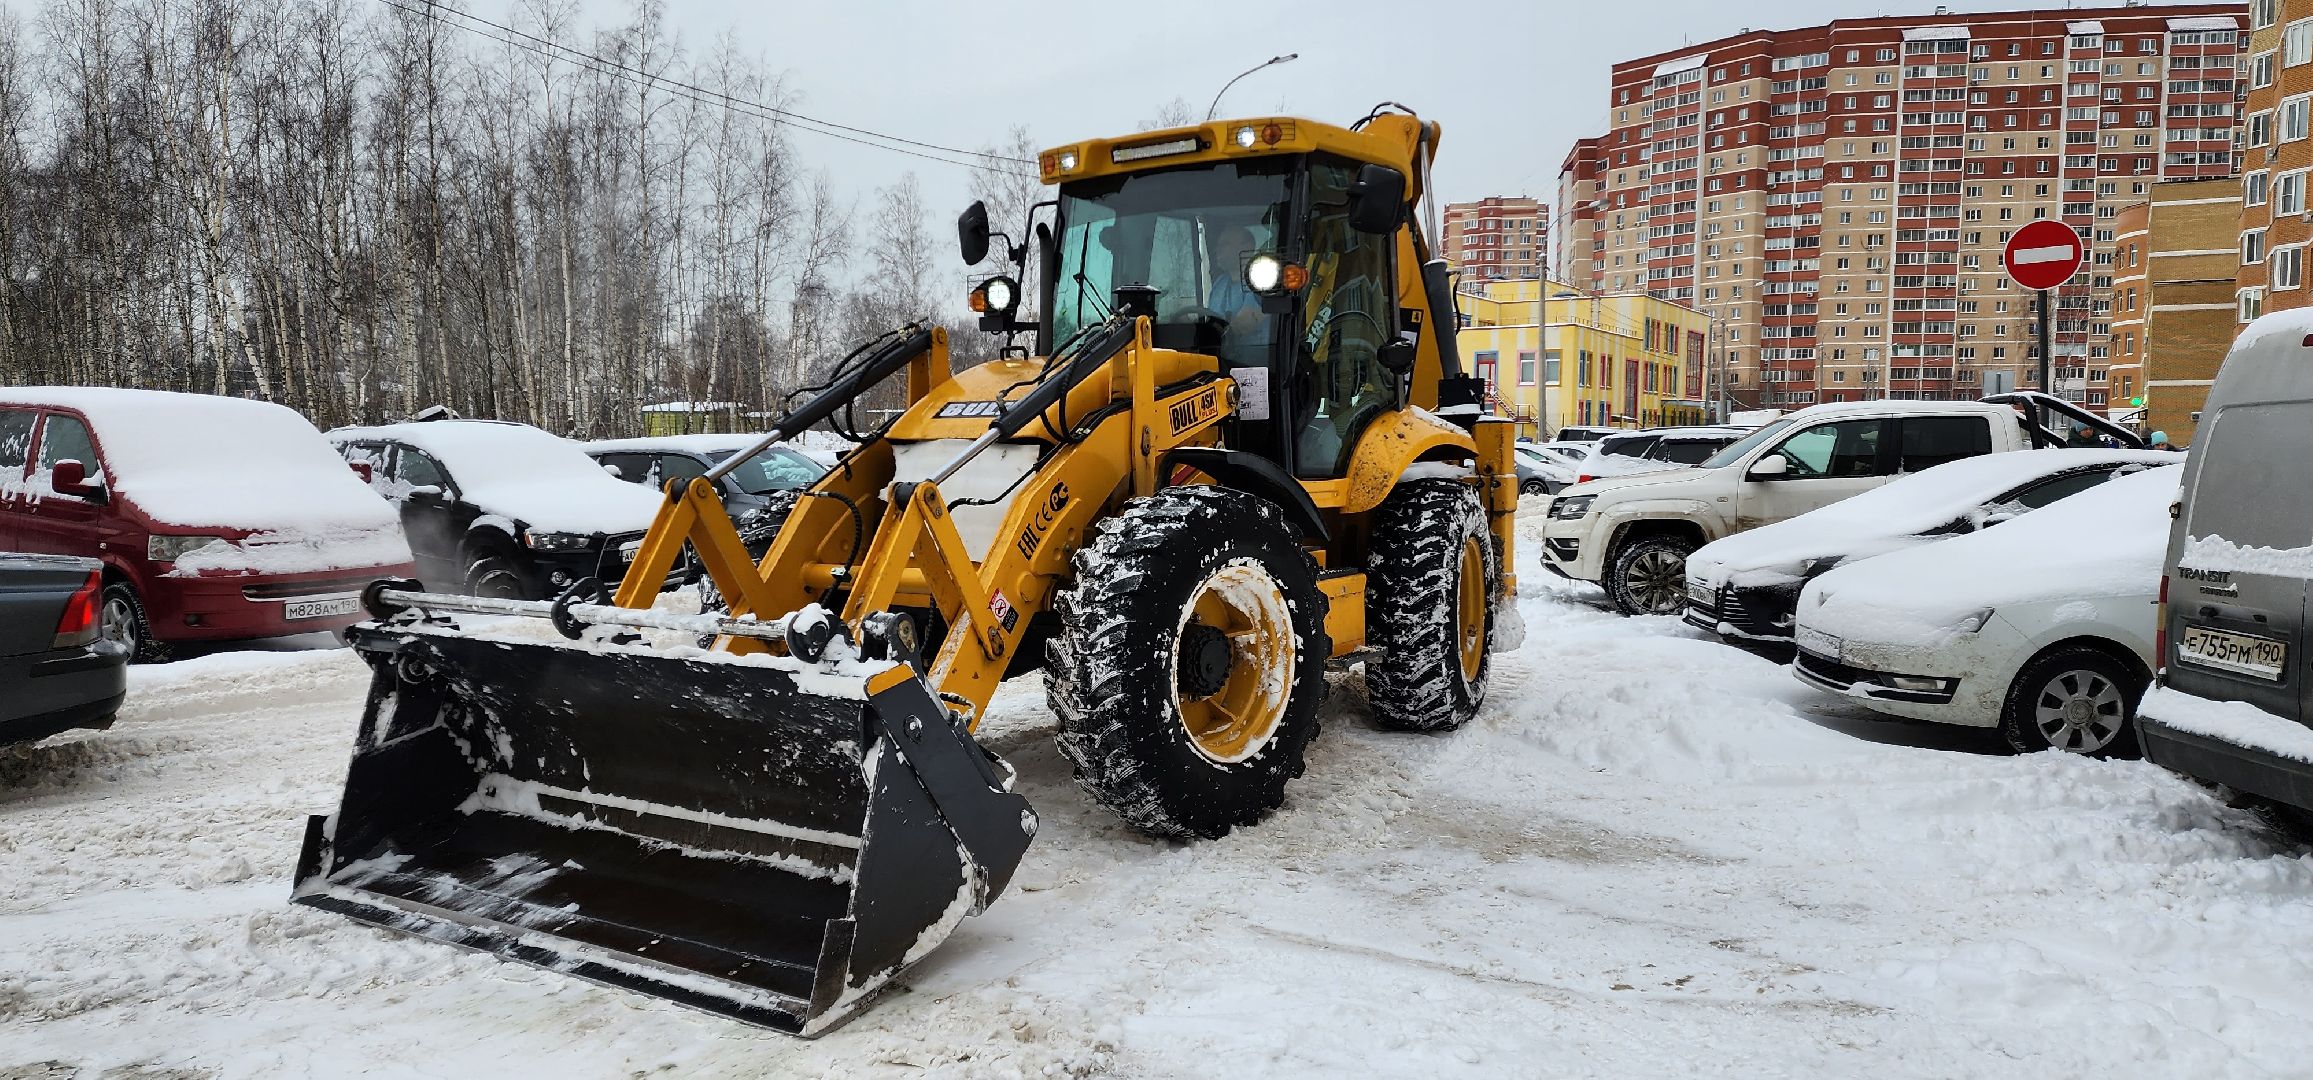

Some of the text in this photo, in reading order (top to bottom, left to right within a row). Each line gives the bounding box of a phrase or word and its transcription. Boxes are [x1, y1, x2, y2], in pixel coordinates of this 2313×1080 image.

[1171, 400, 1199, 431] BULL
[1201, 408, 1216, 418] PLUS
[2177, 567, 2231, 583] TRANSIT
[2255, 642, 2280, 662] 190
